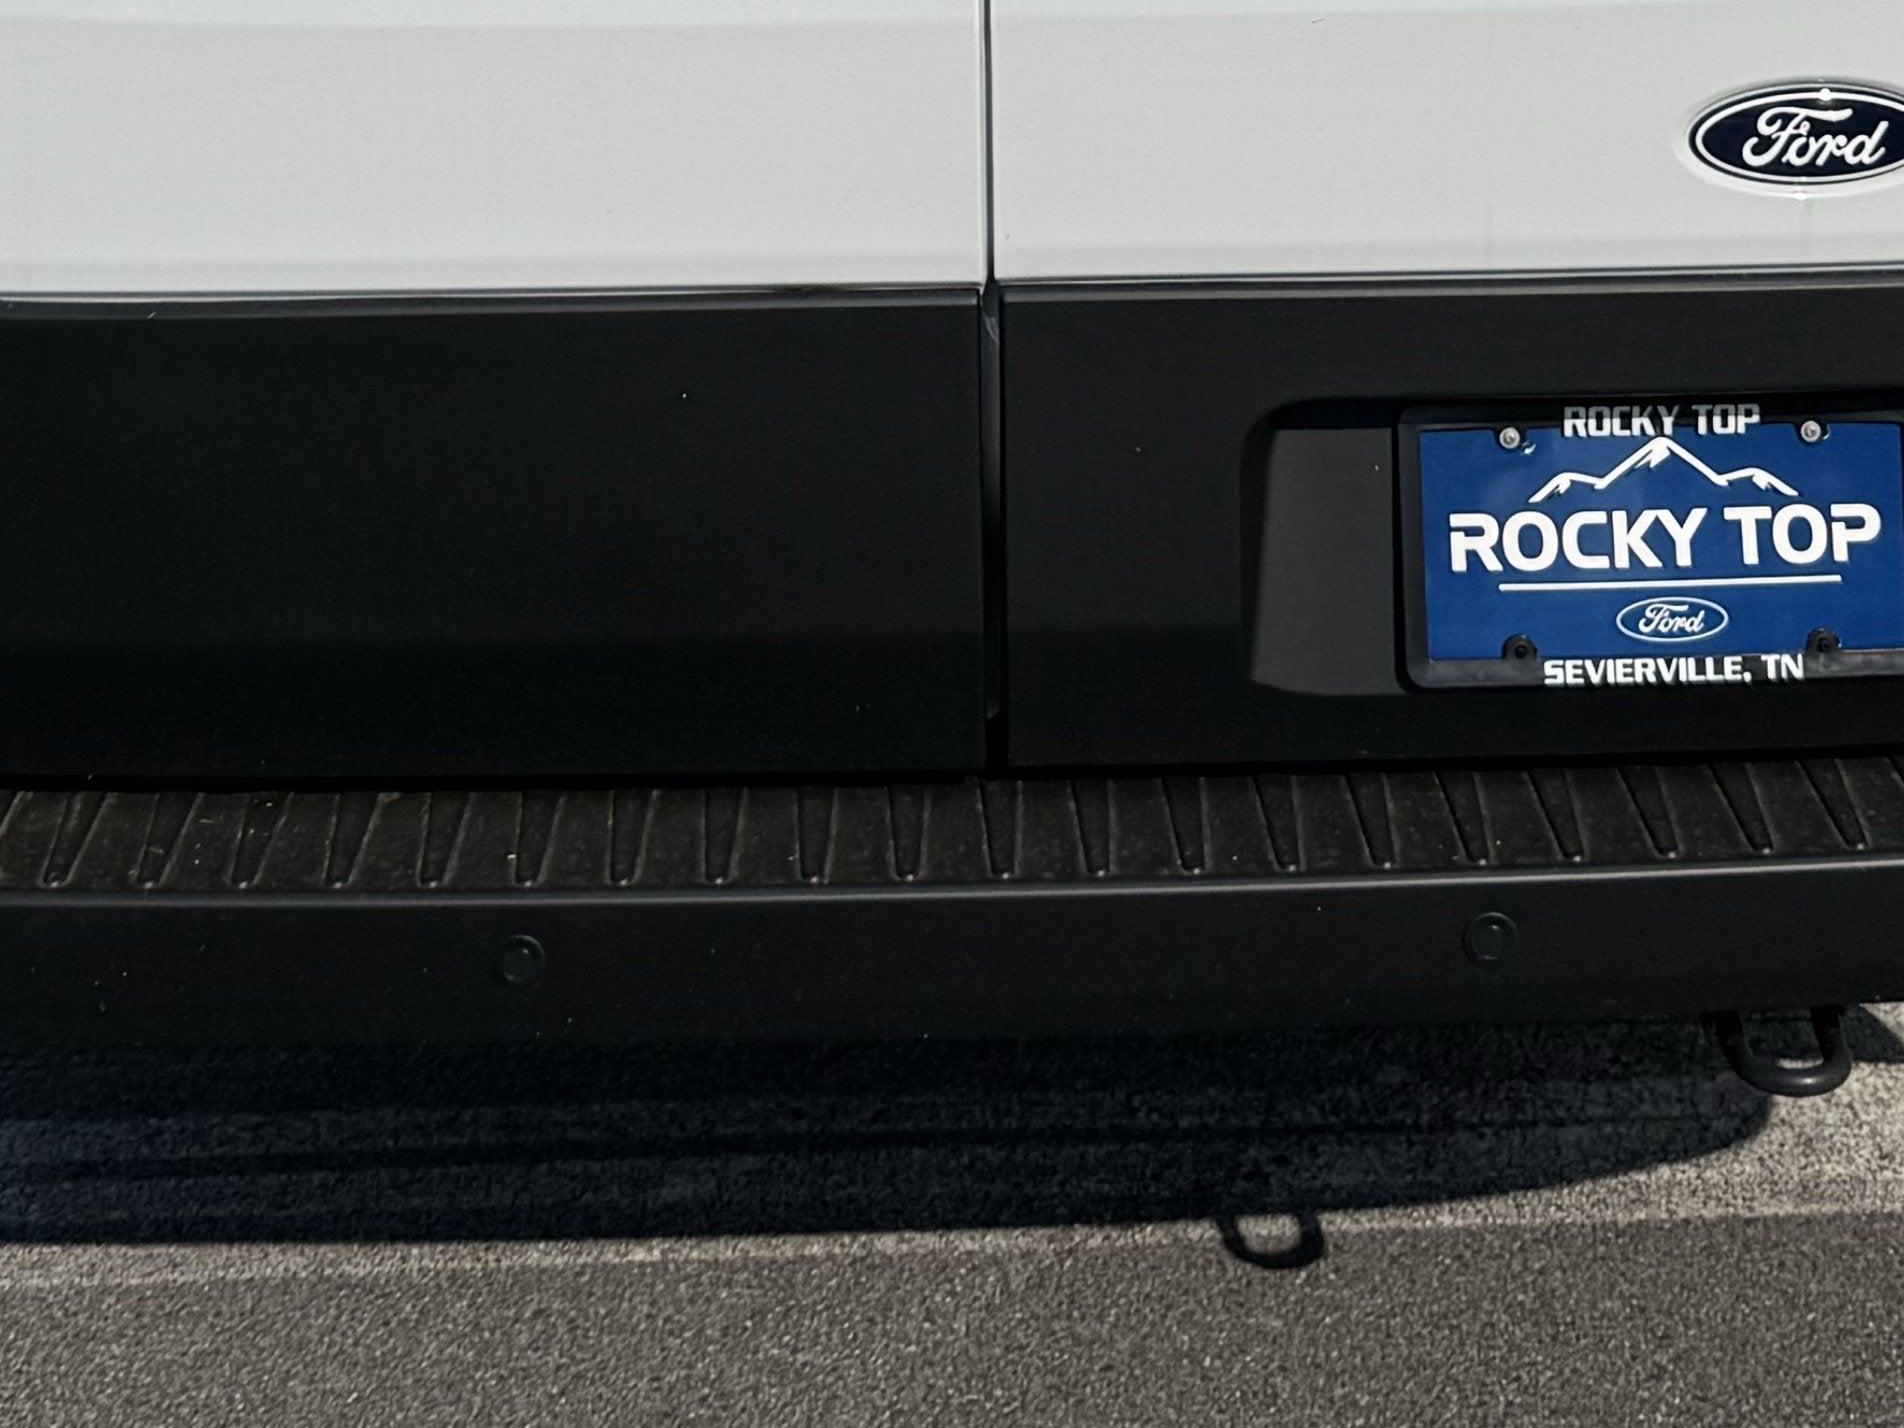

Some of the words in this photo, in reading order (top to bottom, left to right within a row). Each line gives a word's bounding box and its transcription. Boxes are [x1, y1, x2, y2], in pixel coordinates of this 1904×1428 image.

[1741, 106, 1890, 167] Ford
[1563, 405, 1679, 438] ROCKY
[1691, 403, 1761, 436] TOP
[1449, 506, 1708, 573] ROCKY
[1723, 502, 1883, 565] TOP
[1637, 602, 1706, 634] Ford
[1544, 655, 1752, 686] SEVIERVILLE,
[1760, 652, 1804, 680] TN
